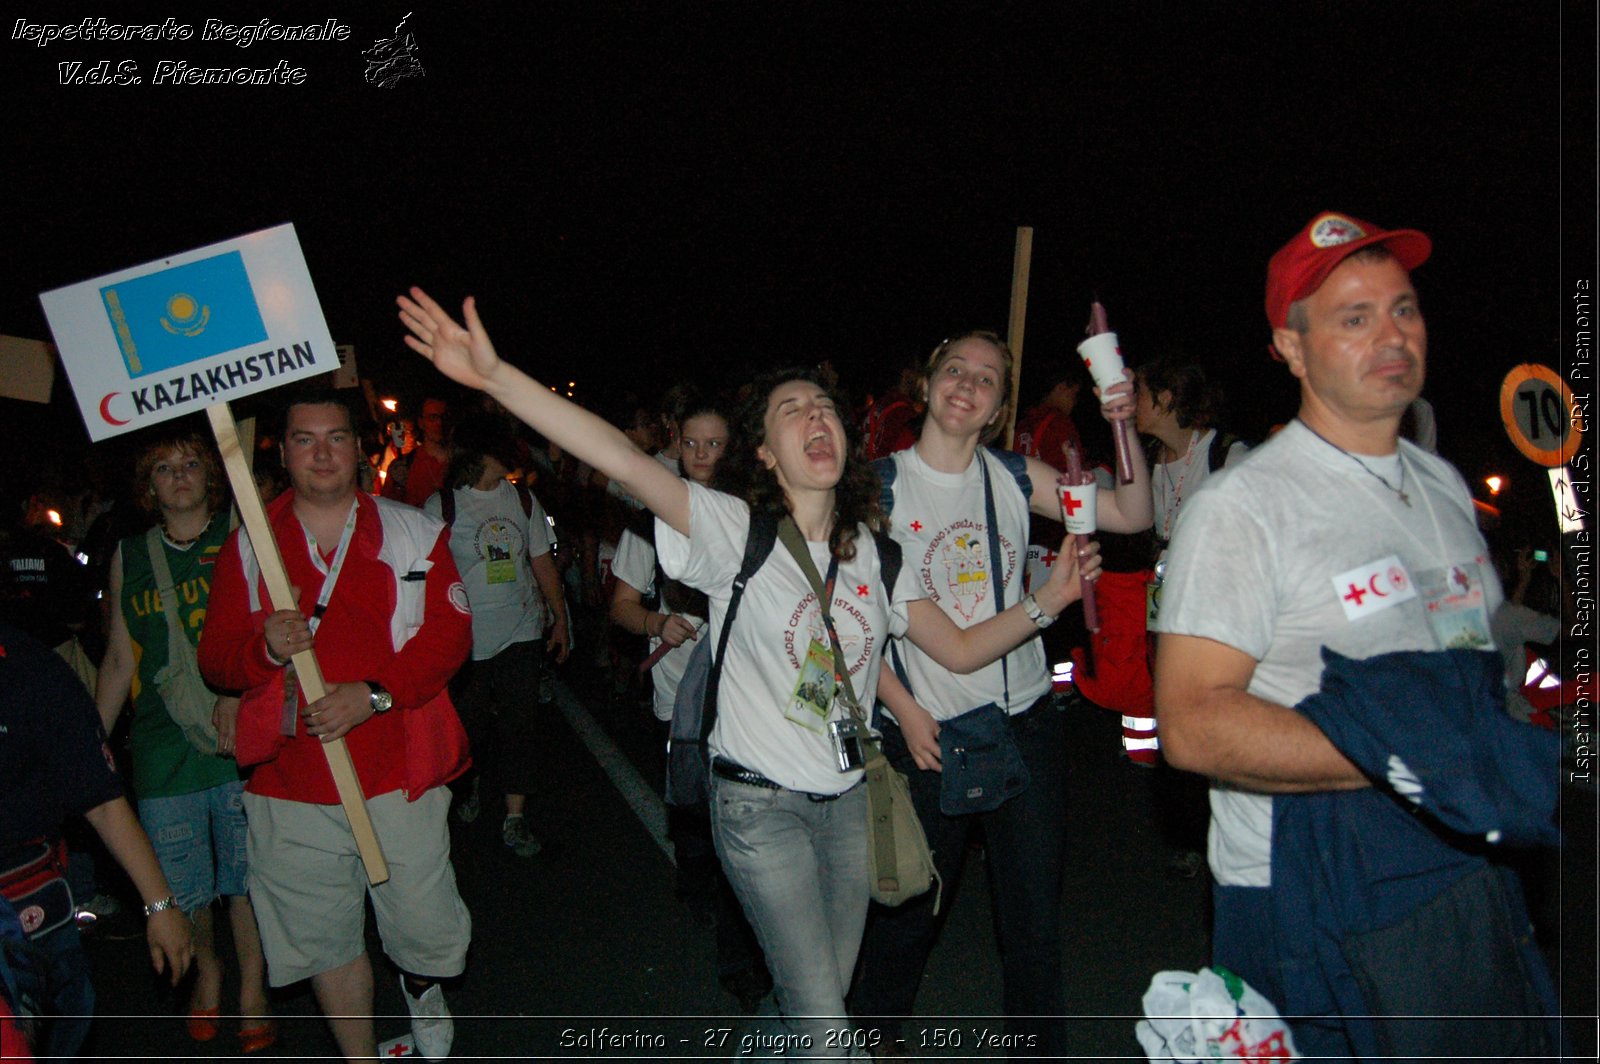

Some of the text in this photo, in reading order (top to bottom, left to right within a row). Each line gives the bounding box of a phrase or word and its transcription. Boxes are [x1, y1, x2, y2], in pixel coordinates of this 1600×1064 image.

[131, 340, 316, 416] KAZAKHSTAN
[1518, 388, 1565, 440] 70
[834, 598, 873, 635] ISTARSKE
